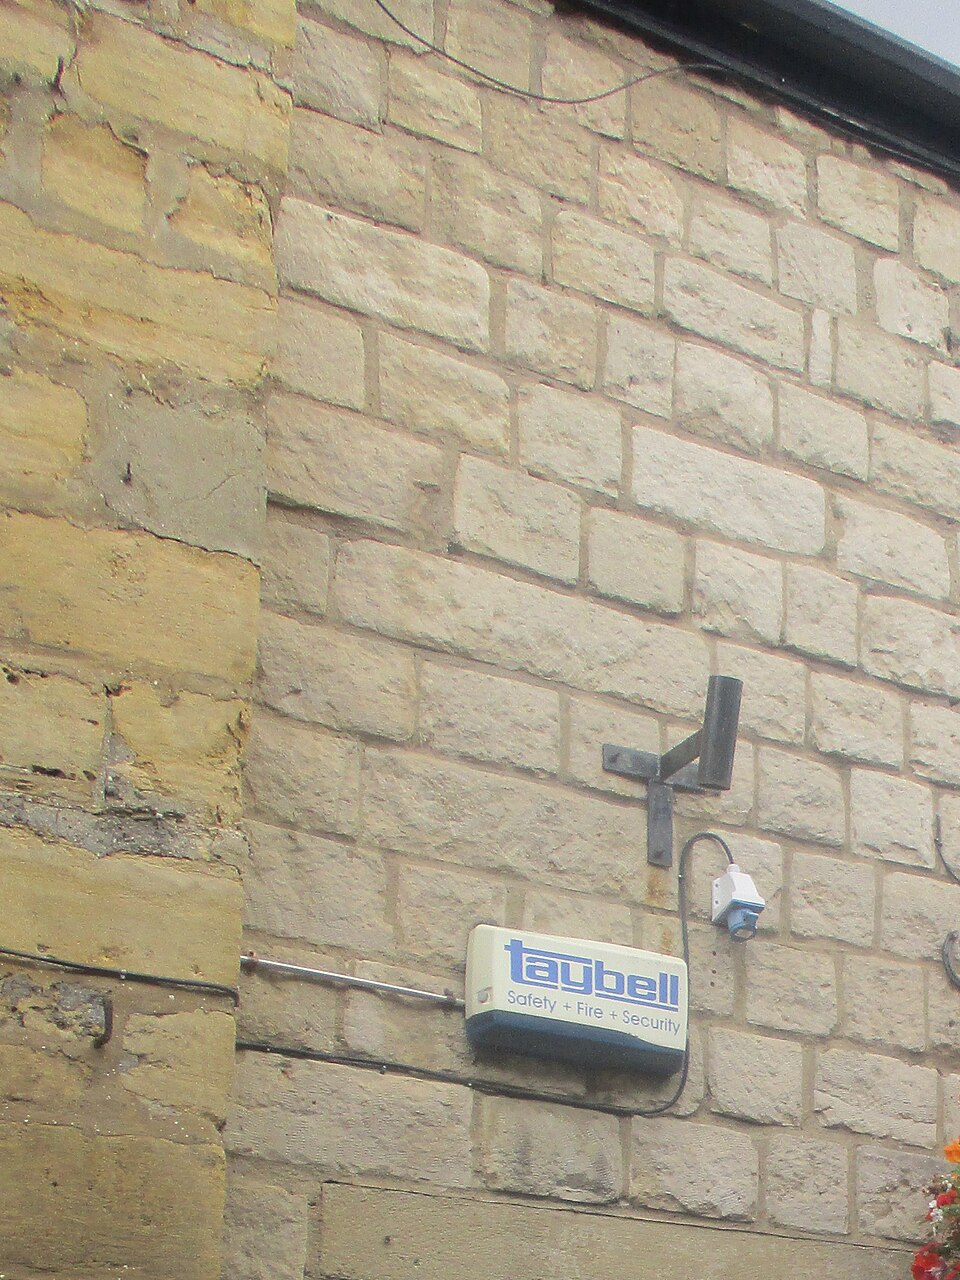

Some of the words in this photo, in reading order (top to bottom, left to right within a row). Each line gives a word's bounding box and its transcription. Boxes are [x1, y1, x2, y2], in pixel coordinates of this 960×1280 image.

[503, 938, 679, 1012] taybell
[507, 990, 557, 1013] Safety
[563, 1002, 572, 1011] +
[577, 1003, 604, 1020] Fire
[609, 1010, 618, 1020] +
[622, 1010, 681, 1035] Security
